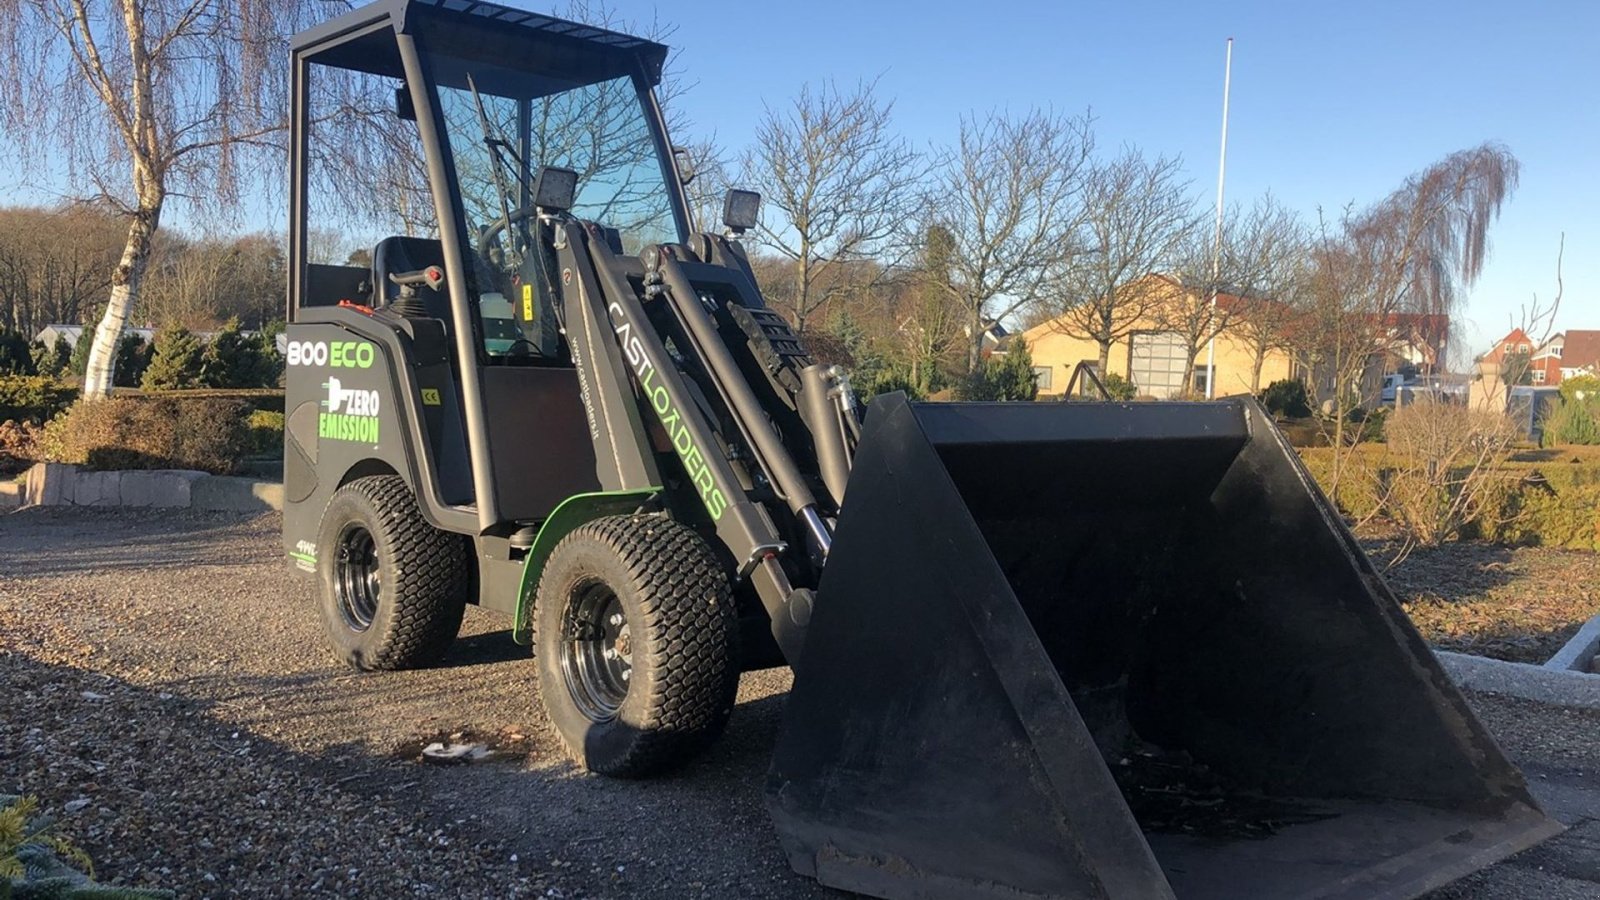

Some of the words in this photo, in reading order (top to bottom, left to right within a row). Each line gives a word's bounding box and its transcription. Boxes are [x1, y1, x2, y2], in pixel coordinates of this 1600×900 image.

[287, 341, 328, 366] 800
[330, 341, 375, 369] ECO
[345, 389, 380, 417] ZERO
[572, 337, 600, 440] www.castloaders.it
[609, 302, 727, 520] CASTLOADERS
[319, 412, 380, 443] EMISSION
